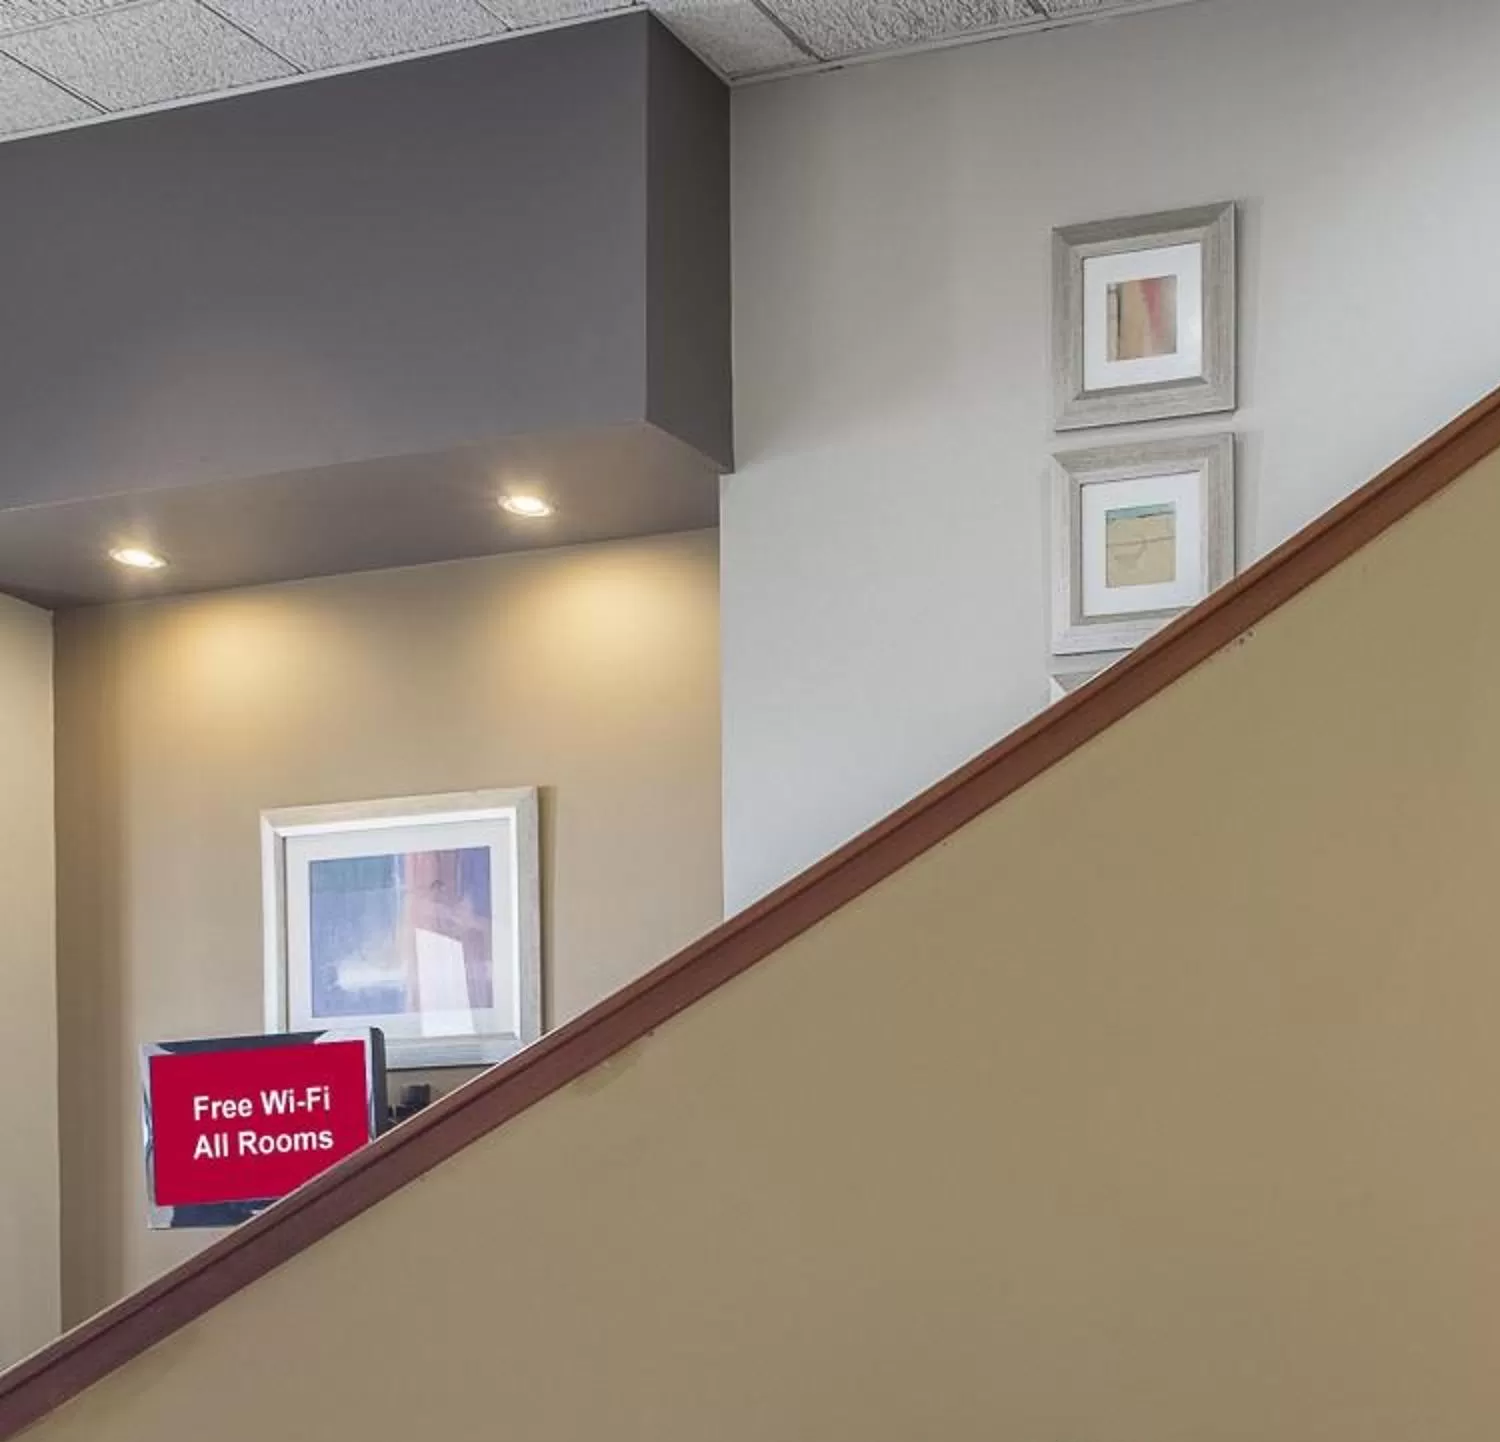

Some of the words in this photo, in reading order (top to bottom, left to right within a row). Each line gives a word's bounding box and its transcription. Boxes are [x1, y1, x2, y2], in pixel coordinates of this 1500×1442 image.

[193, 1091, 253, 1121] Free
[259, 1085, 331, 1116] Wi-Fi
[193, 1133, 229, 1160] All
[238, 1127, 334, 1156] Rooms
